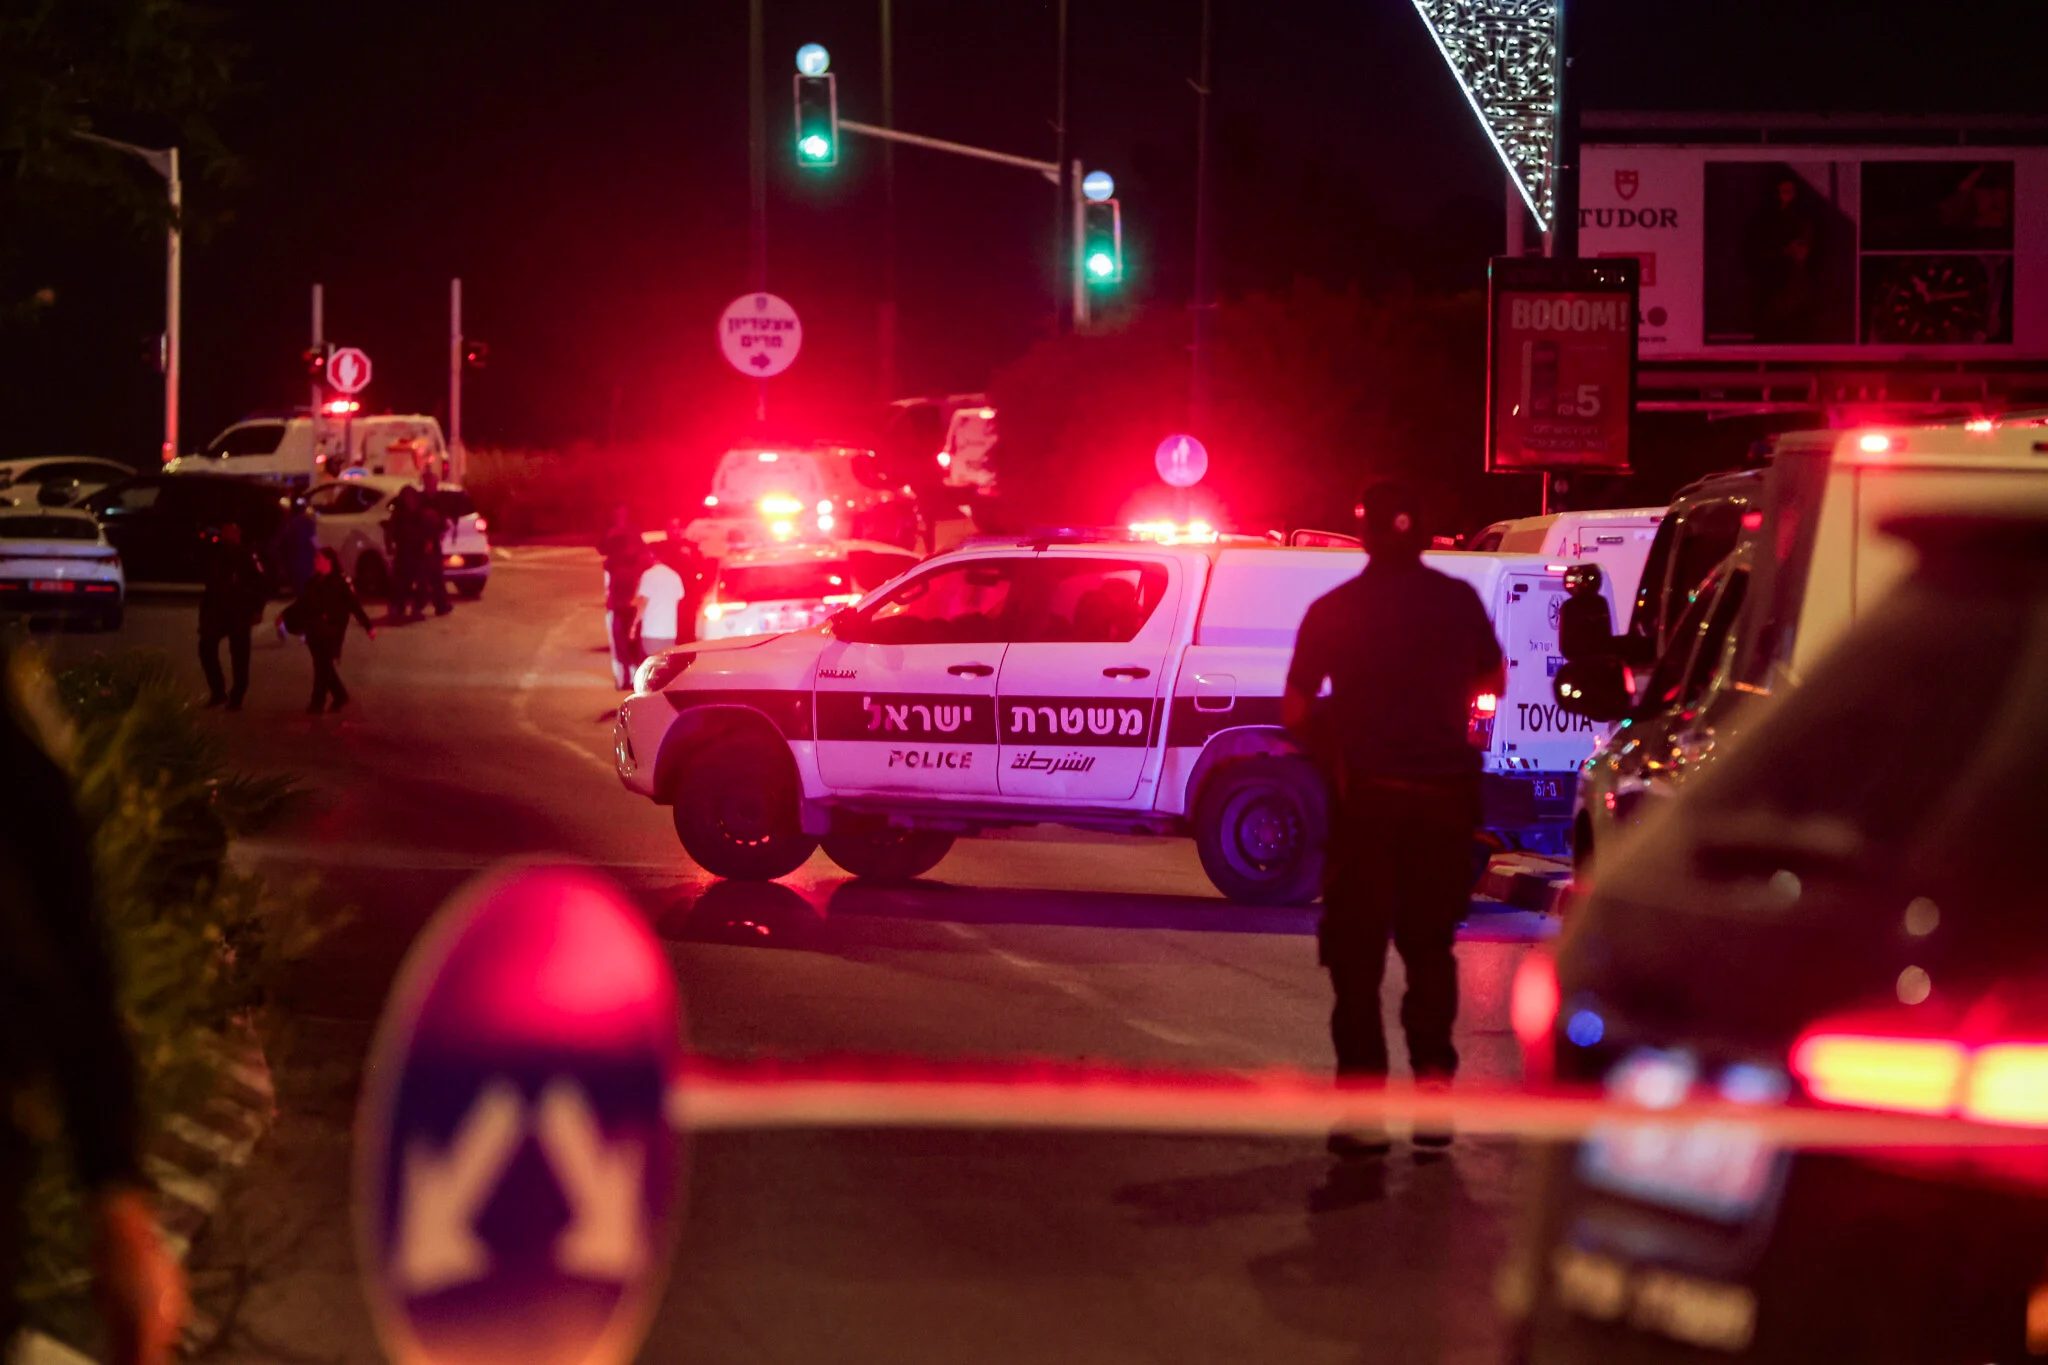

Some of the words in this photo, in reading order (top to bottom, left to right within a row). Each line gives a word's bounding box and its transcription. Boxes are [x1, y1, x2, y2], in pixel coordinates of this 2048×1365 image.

[1578, 207, 1679, 228] TUDOR
[1511, 298, 1628, 332] BOOOM!
[863, 696, 972, 732] ישראל
[1011, 706, 1143, 737] משטרת
[1517, 703, 1593, 733] TOYOTA
[888, 750, 972, 769] POLICE
[1011, 750, 1095, 775] الشرطة
